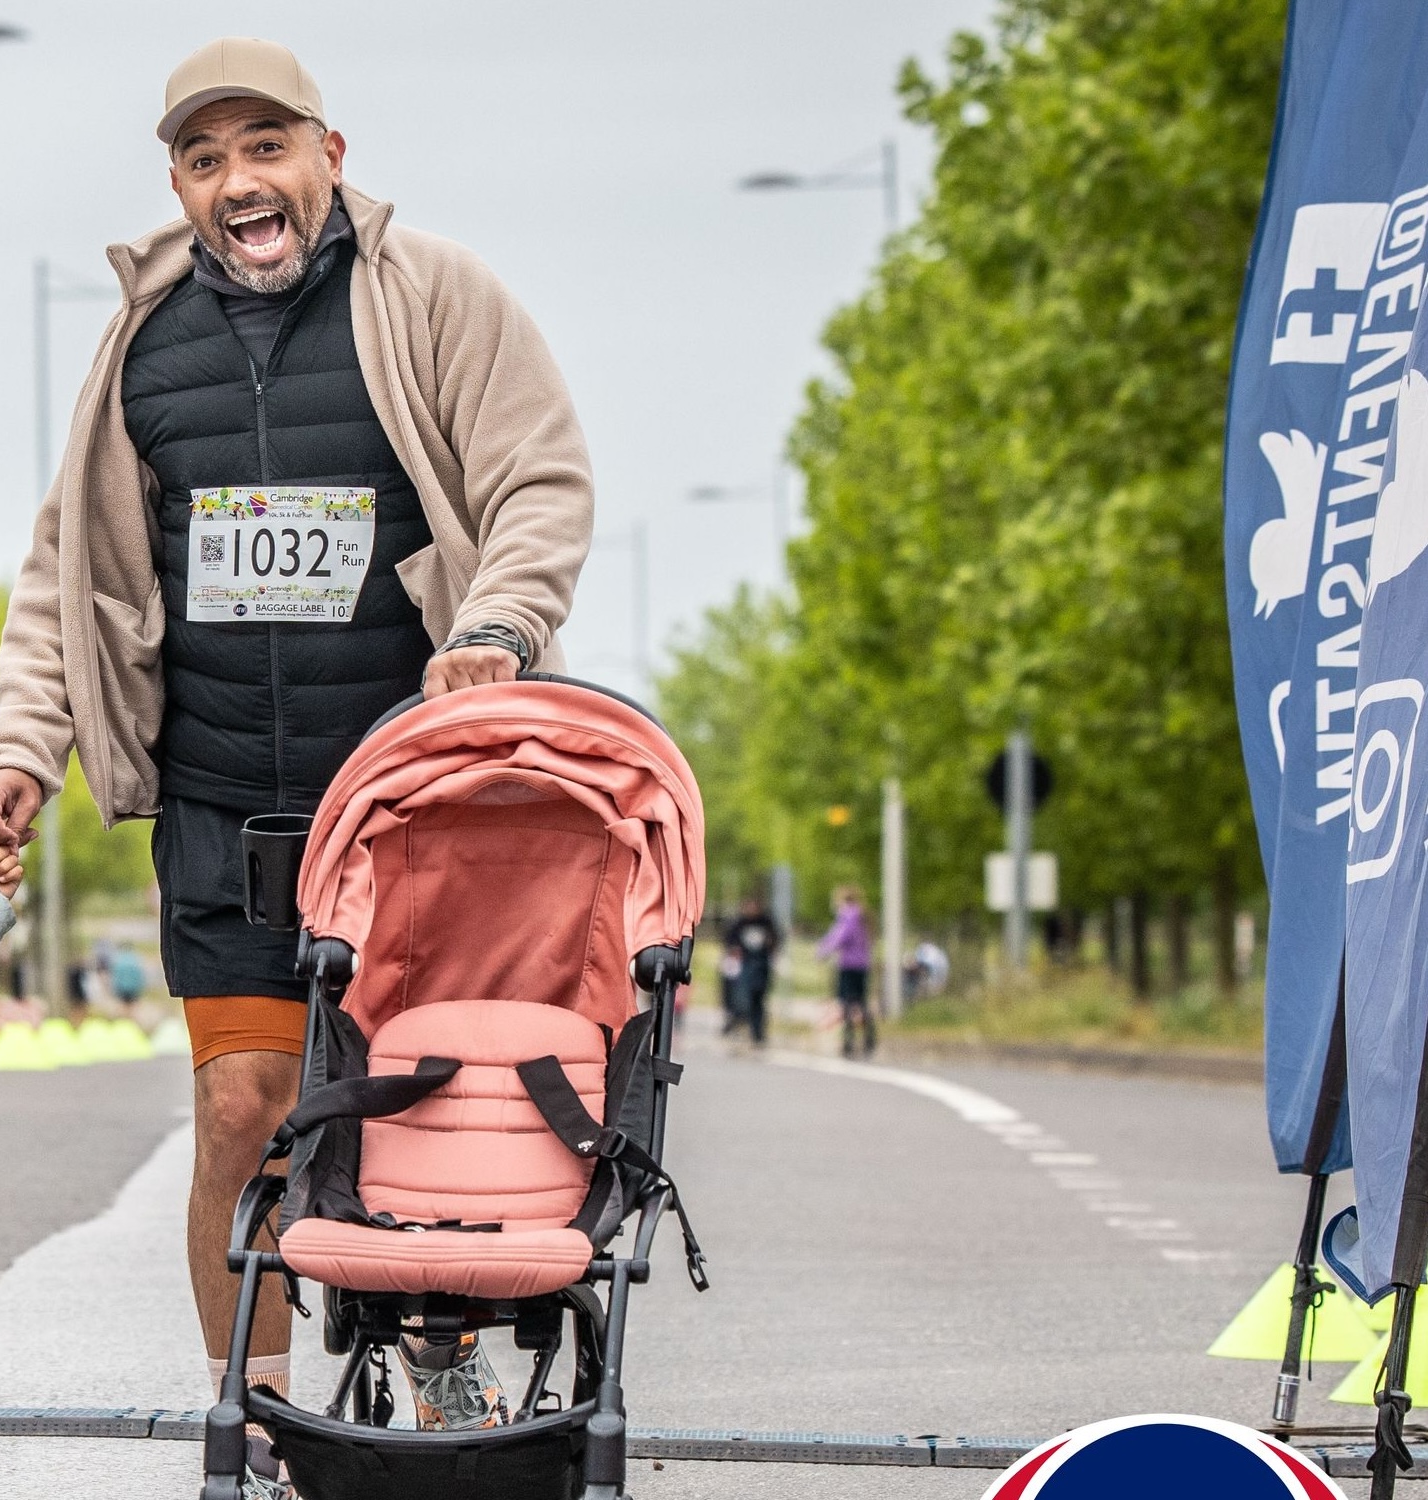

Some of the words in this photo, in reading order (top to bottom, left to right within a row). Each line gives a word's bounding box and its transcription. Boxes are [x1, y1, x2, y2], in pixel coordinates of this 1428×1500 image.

[270, 493, 313, 504] Cambridge
[336, 539, 358, 551] Fun
[233, 528, 331, 577] 1032
[342, 554, 365, 566] Run
[256, 603, 298, 612] BAGGAGE
[300, 604, 326, 612] LABEL
